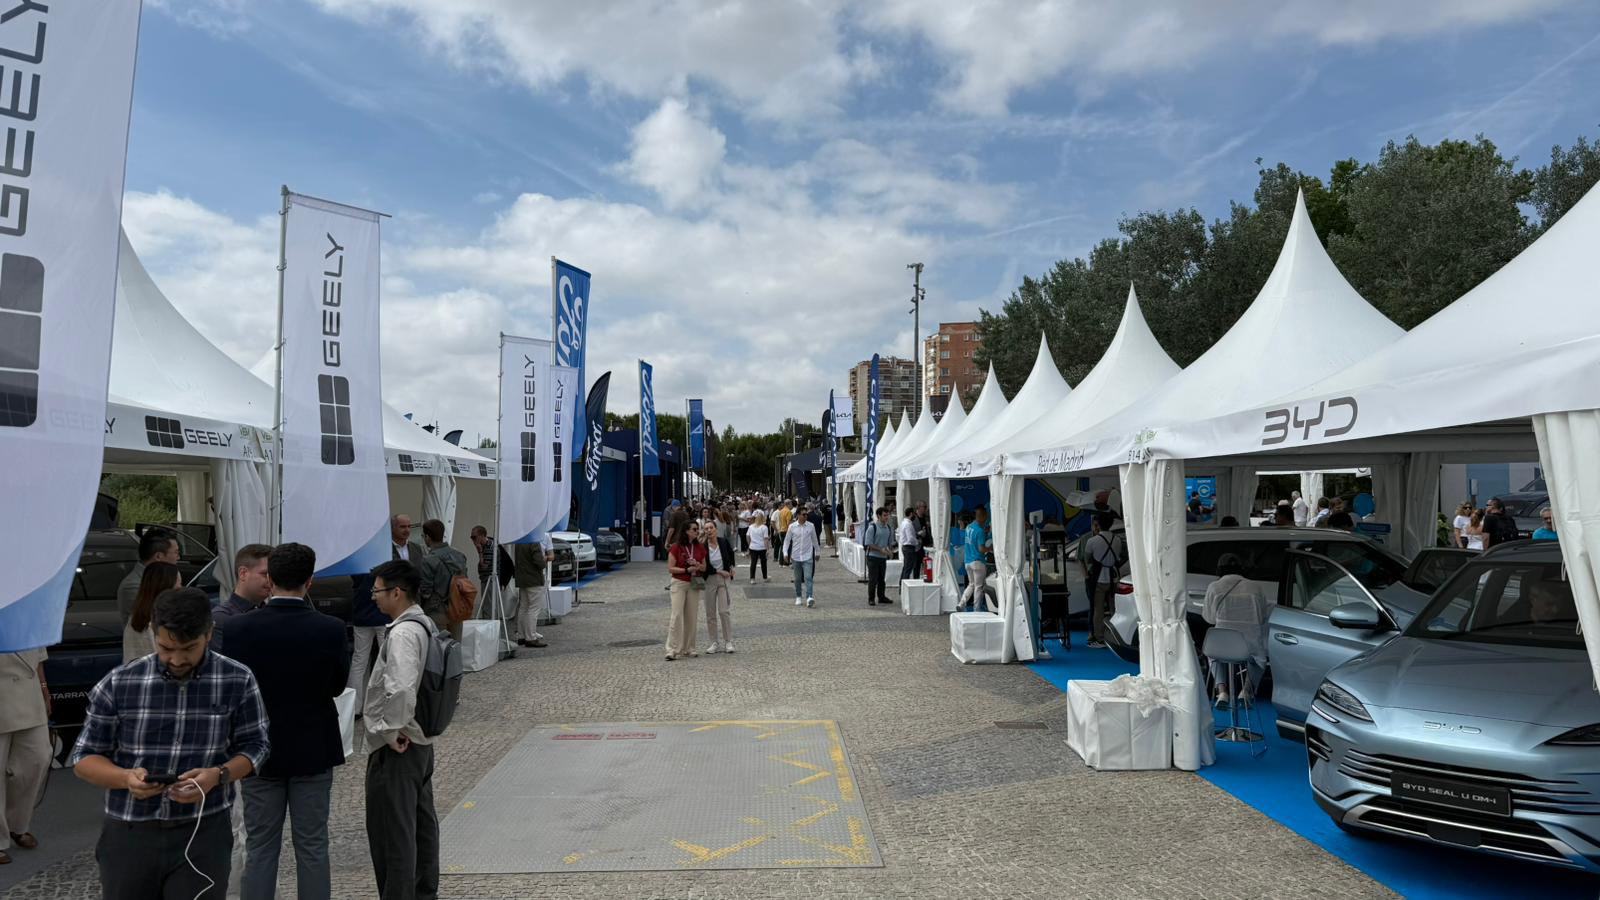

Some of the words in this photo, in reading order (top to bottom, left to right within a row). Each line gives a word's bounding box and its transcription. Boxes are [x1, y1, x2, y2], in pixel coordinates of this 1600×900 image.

[323, 232, 344, 367] GEELY
[524, 354, 535, 427] GEELY
[554, 379, 564, 438] GEELY
[642, 369, 658, 457] Ford
[184, 428, 233, 447] GEELY
[1262, 396, 1359, 446] BYD
[865, 379, 876, 521] CHANGAN
[956, 461, 972, 476] BYD
[1037, 453, 1050, 472] Red
[1050, 452, 1058, 472] de
[1059, 448, 1085, 471] Madrid
[1402, 783, 1426, 792] BYD
[1428, 787, 1459, 798] SEAL
